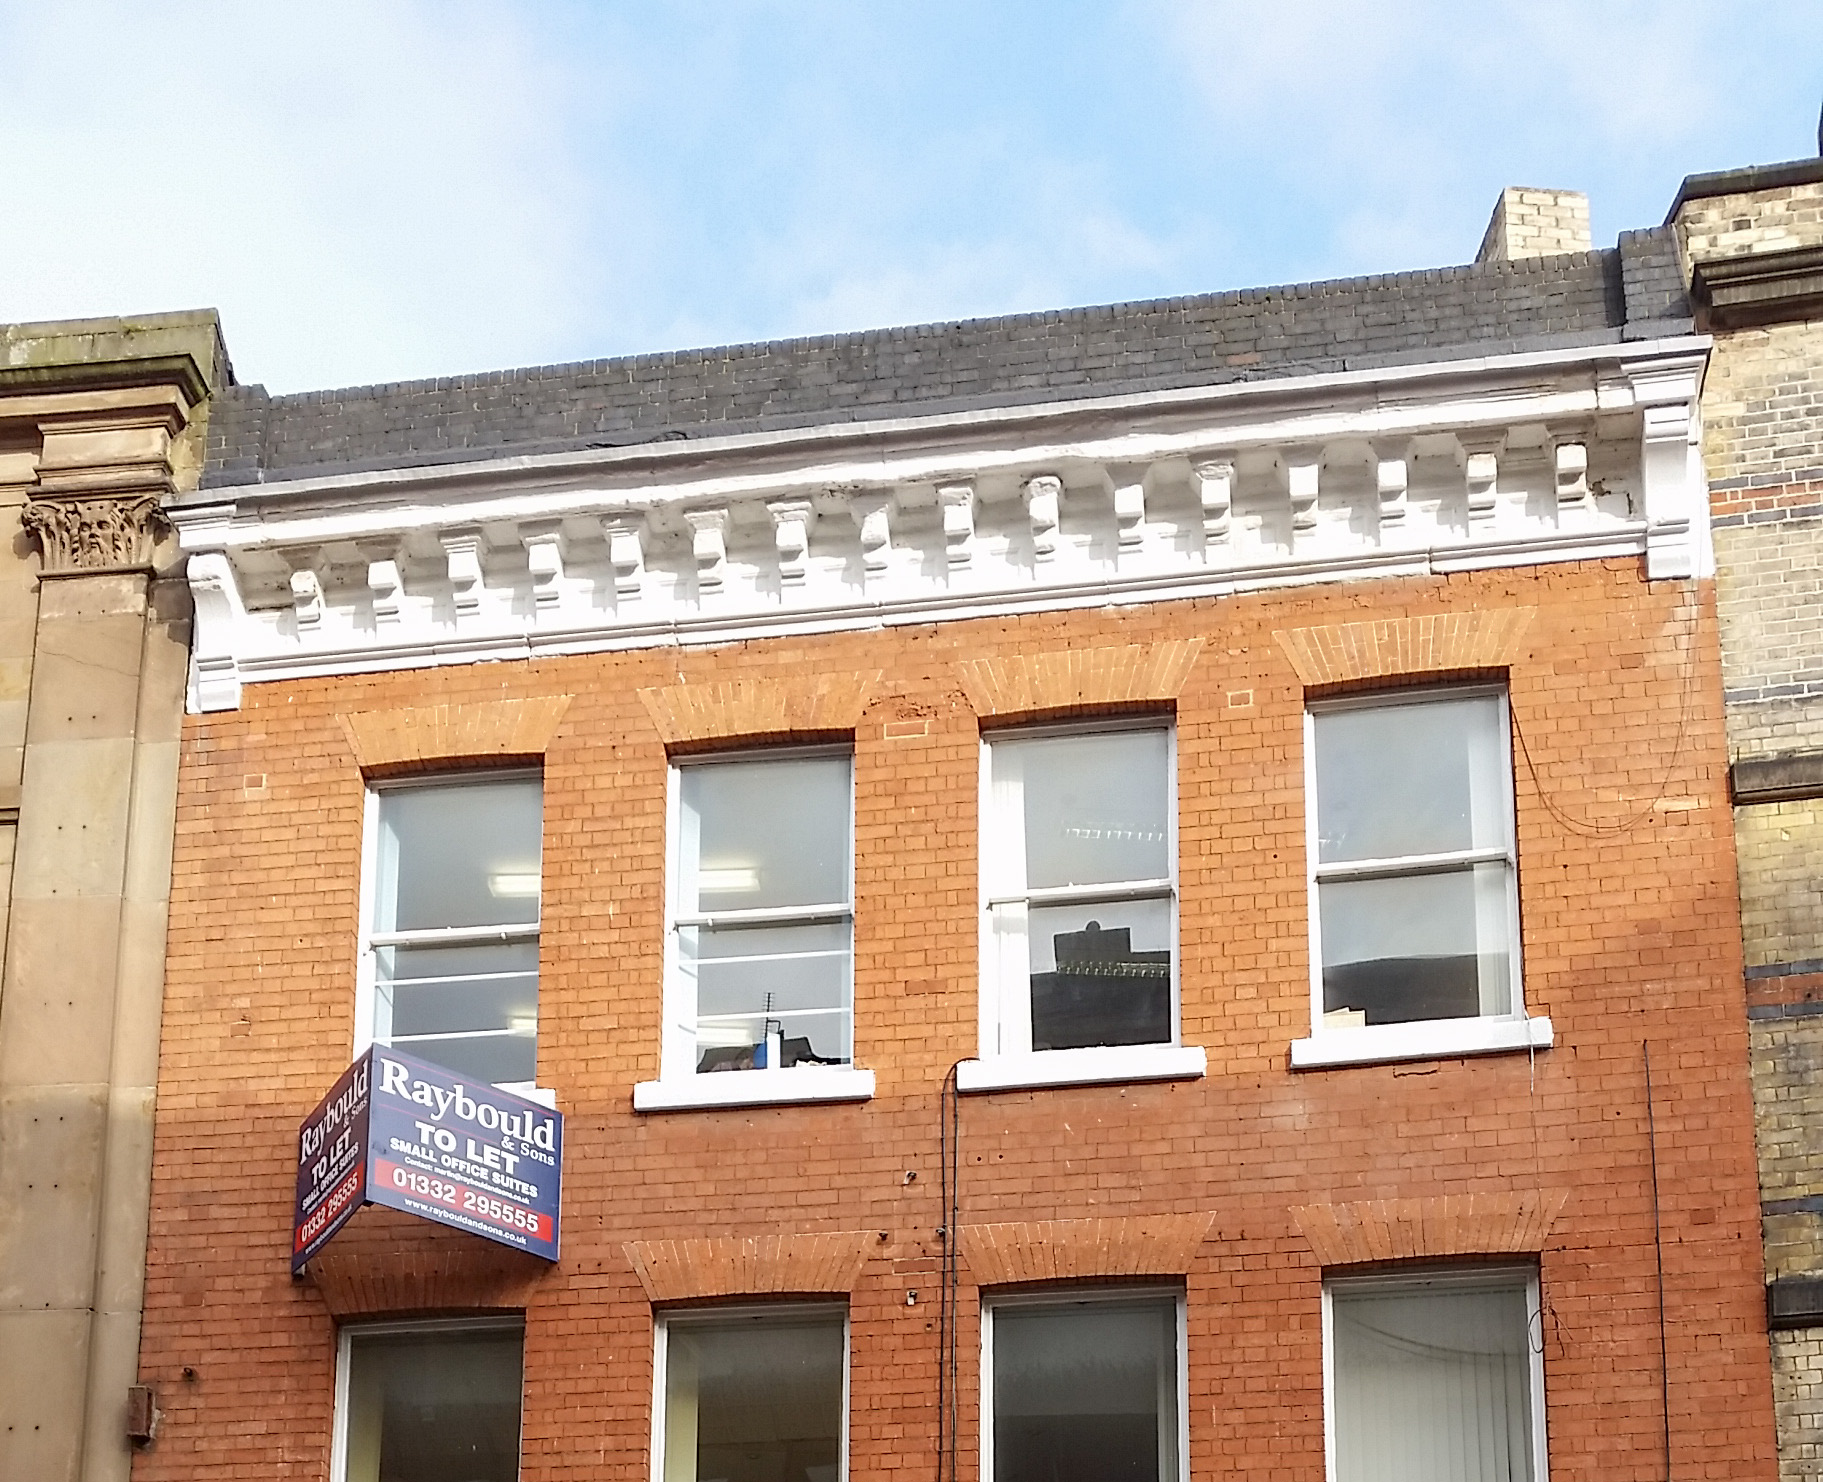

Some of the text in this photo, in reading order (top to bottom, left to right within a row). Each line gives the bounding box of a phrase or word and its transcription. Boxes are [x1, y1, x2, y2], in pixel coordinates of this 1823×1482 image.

[300, 1059, 368, 1165] Raybould
[351, 1097, 368, 1120] Sons
[379, 1057, 555, 1152] Raybould
[312, 1156, 327, 1185] TO
[330, 1127, 352, 1167] LET
[390, 1137, 538, 1198] SMALL OFFICE SUITES
[415, 1121, 519, 1175] TO LET
[500, 1135, 555, 1166] & Sons
[301, 1207, 325, 1242] 01332
[328, 1172, 358, 1217] 295555
[392, 1168, 456, 1204] 01332
[464, 1191, 538, 1232] 295555
[405, 1198, 527, 1245] www.raybouldandsons.co.uk
